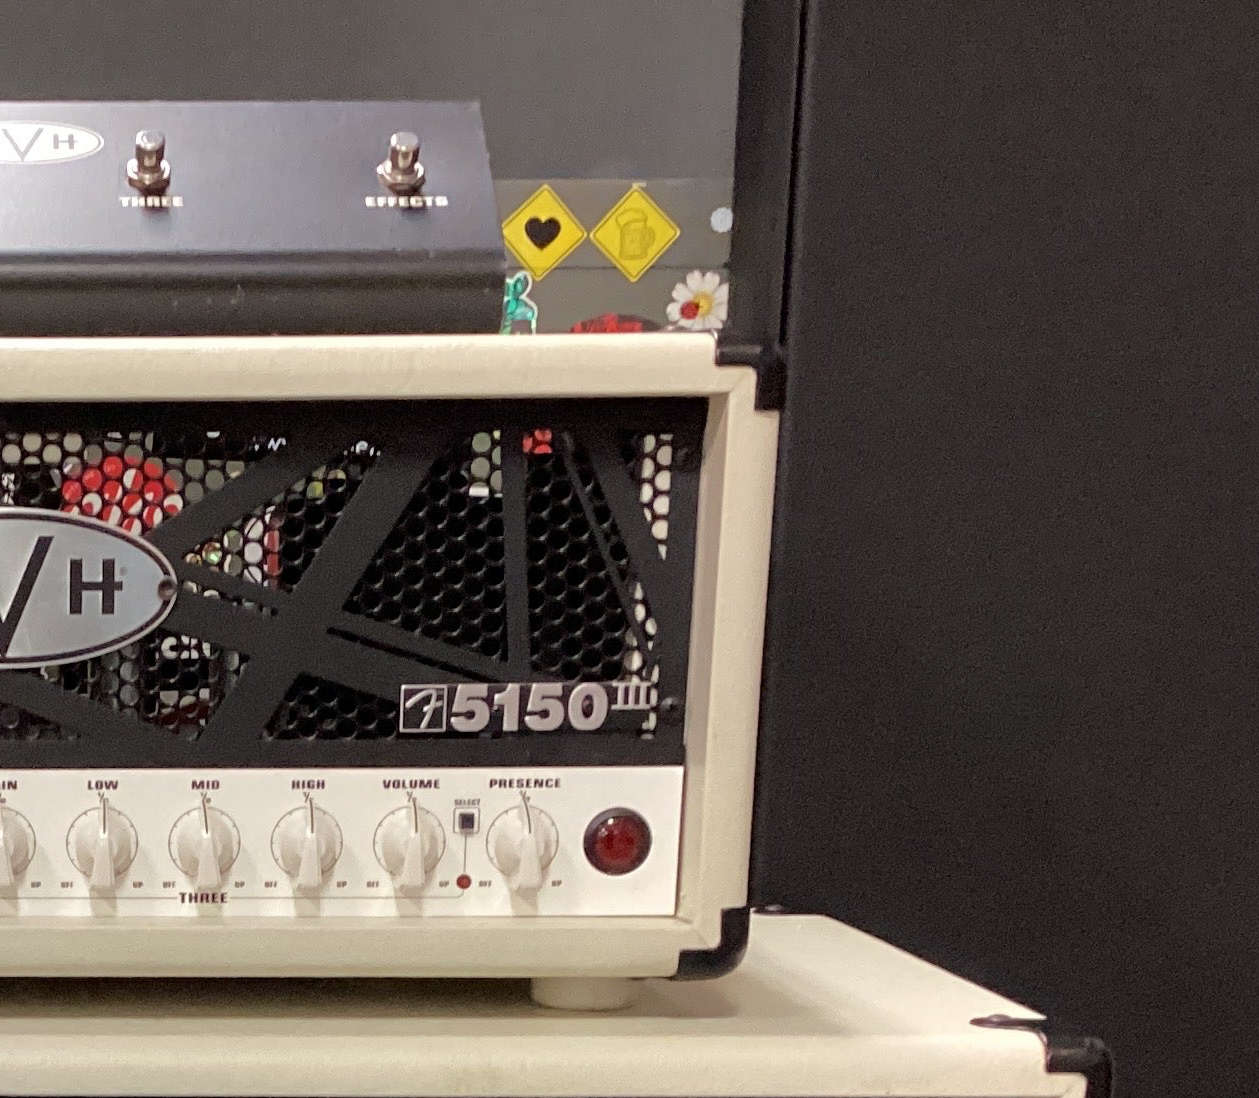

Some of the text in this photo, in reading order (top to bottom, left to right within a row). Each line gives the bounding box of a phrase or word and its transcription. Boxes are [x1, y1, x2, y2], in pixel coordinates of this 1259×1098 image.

[364, 195, 449, 208] EFFECTS
[87, 780, 119, 791] LOW
[191, 780, 220, 790] MID
[291, 779, 326, 790] HIGH
[382, 779, 440, 789] VOLUME
[489, 778, 561, 789] PRESENCE
[179, 892, 228, 904] THREE
